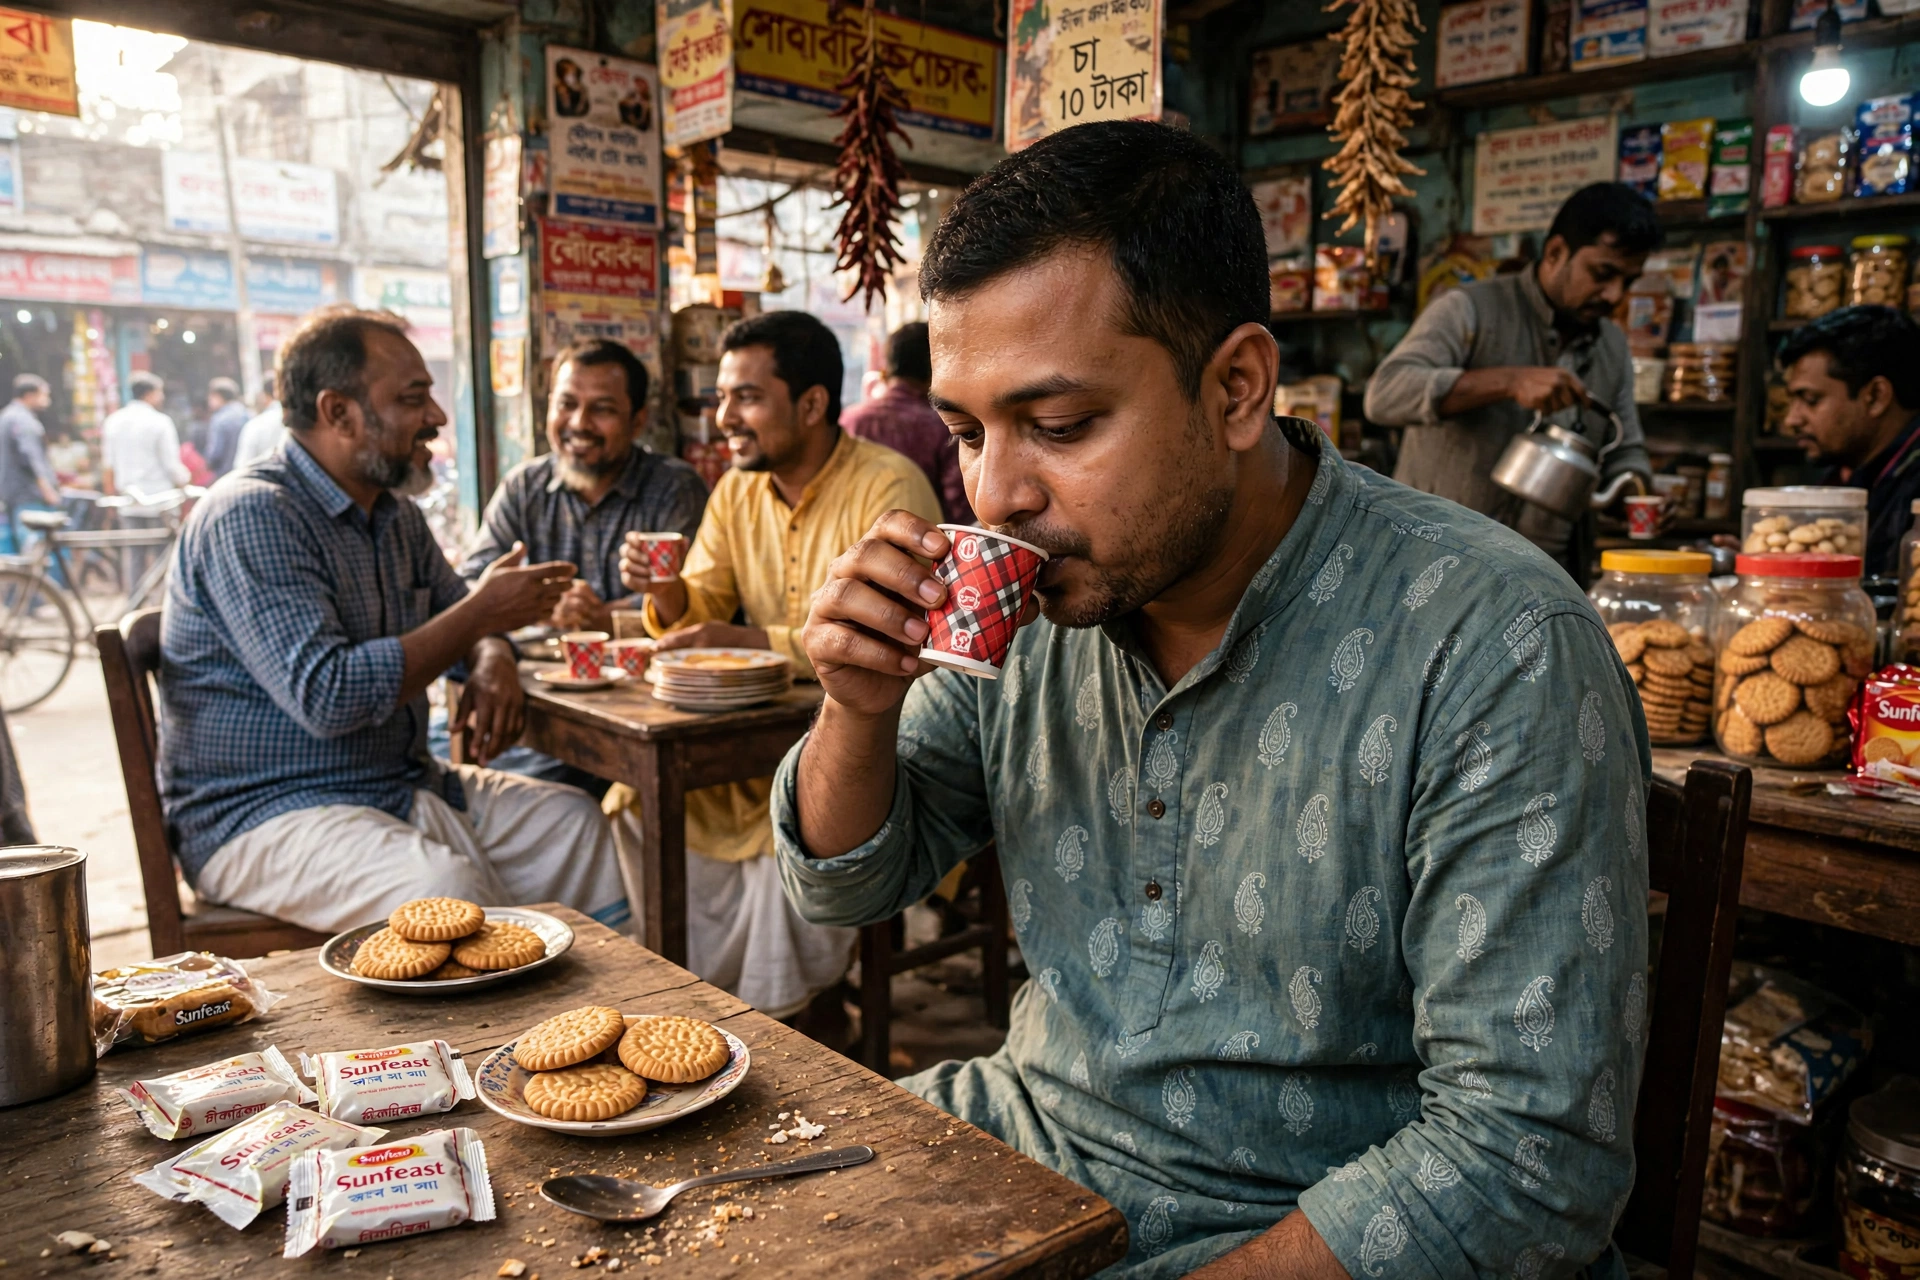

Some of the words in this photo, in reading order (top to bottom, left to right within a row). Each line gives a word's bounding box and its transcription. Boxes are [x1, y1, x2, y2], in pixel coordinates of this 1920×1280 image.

[1069, 36, 1101, 73] চা
[1060, 87, 1084, 120] 10
[1090, 68, 1149, 110] টাকা
[1877, 700, 1920, 722] Sunf
[339, 1057, 432, 1080] Sunfeast
[220, 1119, 315, 1170] Sunfeast
[336, 1161, 446, 1193] Sunfeast
